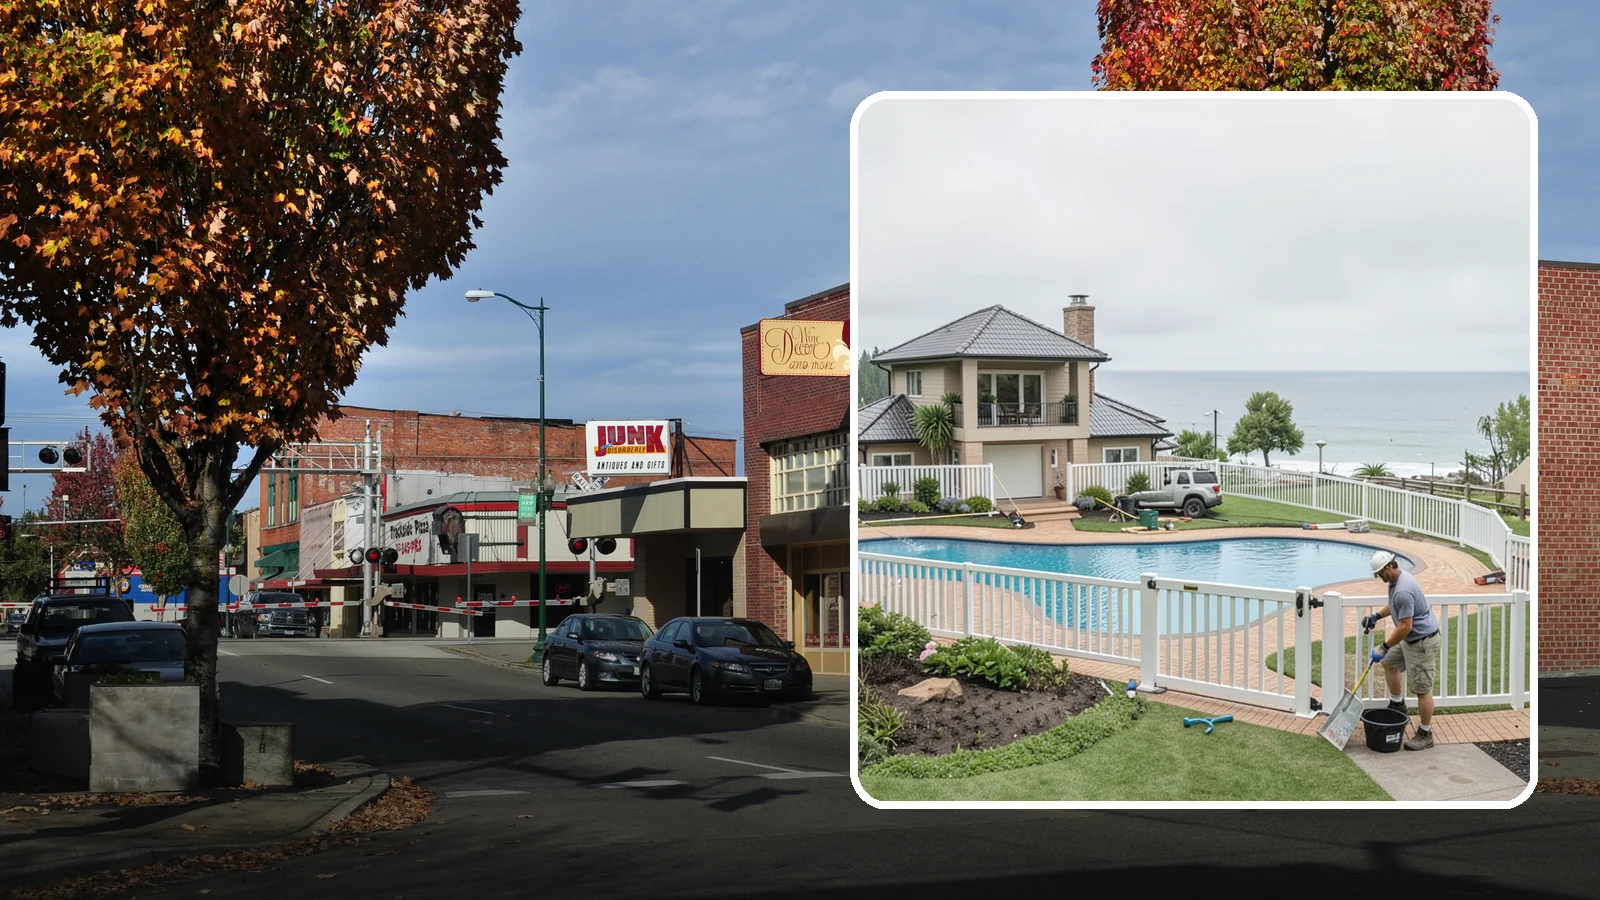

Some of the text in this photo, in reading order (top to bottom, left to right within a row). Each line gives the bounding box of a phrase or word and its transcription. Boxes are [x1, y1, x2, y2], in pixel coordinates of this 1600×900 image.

[595, 425, 665, 457] JUNK
[607, 446, 646, 454] DISORDERLY
[597, 460, 665, 470] ANTIQUES AND GIFTS
[572, 473, 589, 492] RAIL
[390, 519, 429, 539] Trackside Pizza
